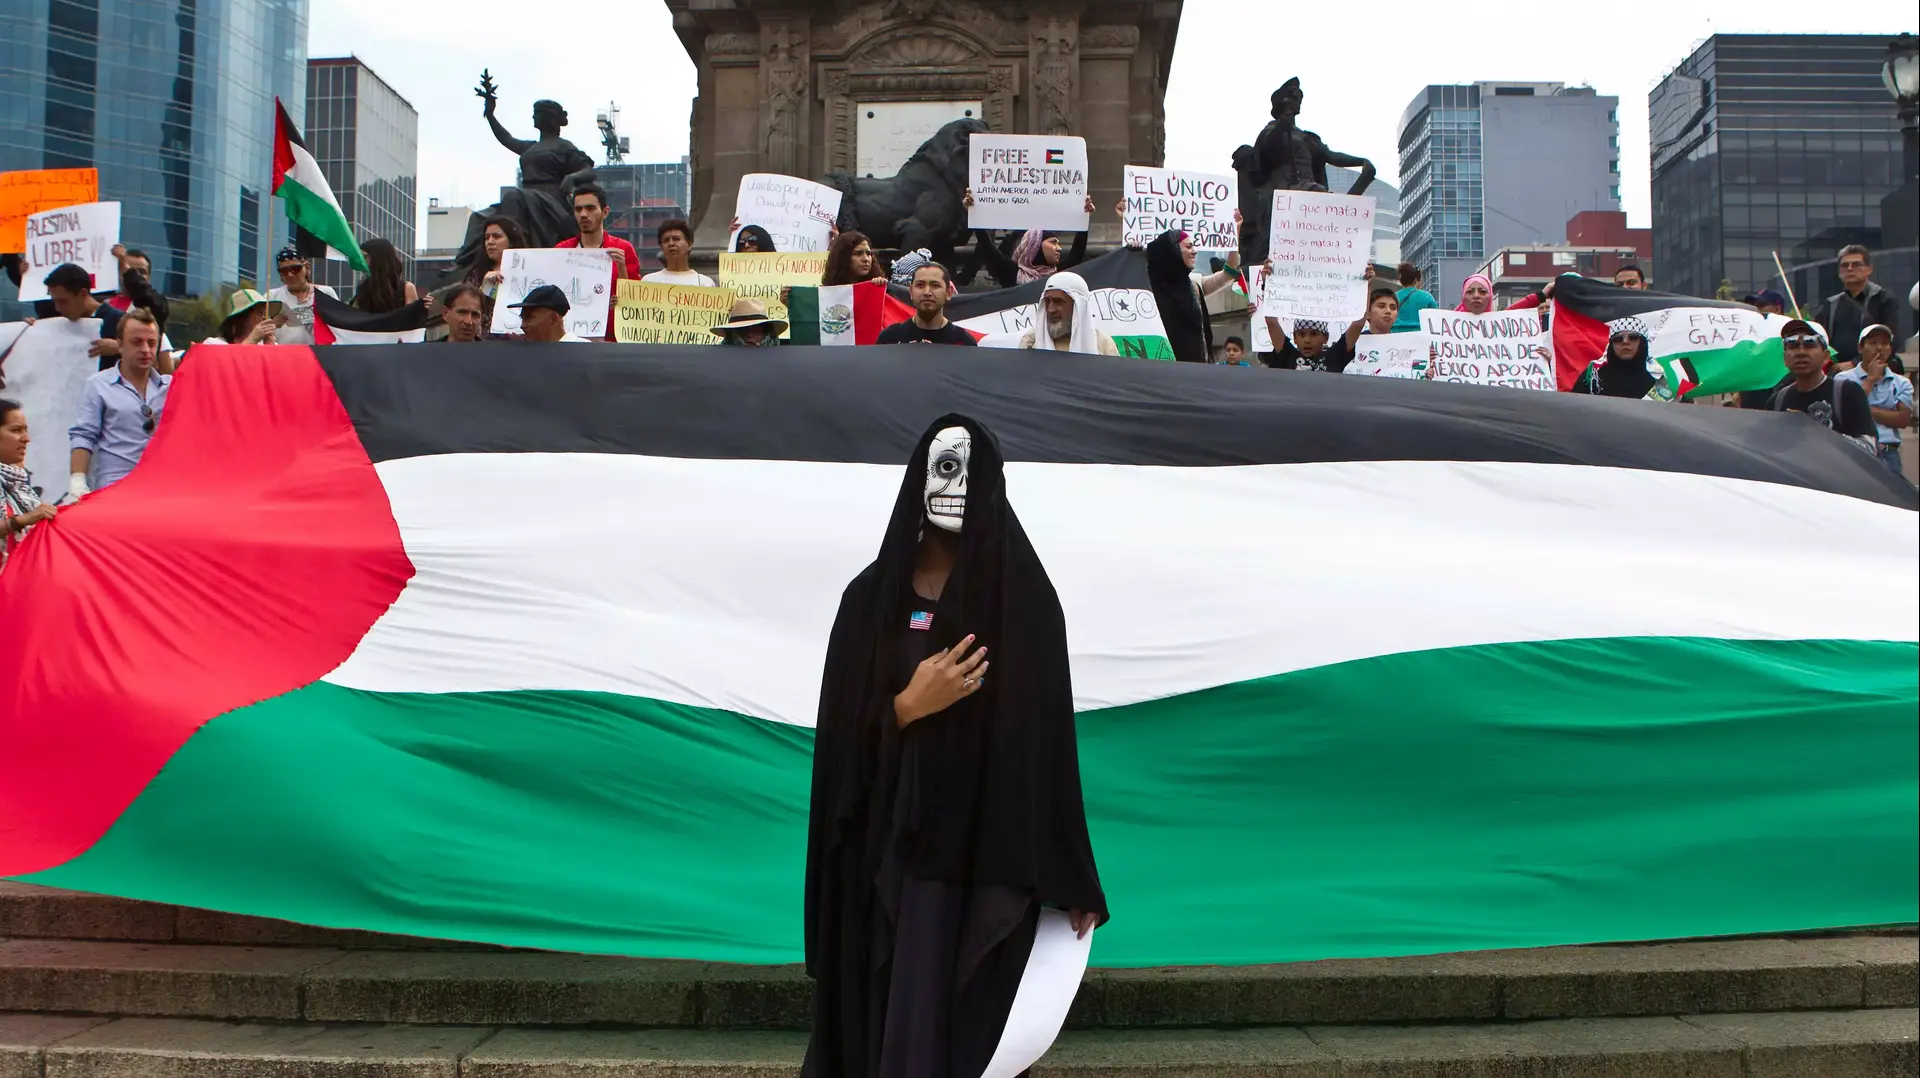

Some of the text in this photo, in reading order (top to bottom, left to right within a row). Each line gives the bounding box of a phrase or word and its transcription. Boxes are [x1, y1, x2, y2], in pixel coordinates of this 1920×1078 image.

[982, 148, 1029, 165] FREE
[980, 167, 1085, 185] PALESTINA
[805, 185, 818, 200] el
[1127, 196, 1216, 219] MEDIO DE
[1275, 195, 1370, 219] El que mata a
[26, 211, 82, 240] PALESTINA
[1124, 215, 1236, 237] VENCER UNA
[1345, 226, 1360, 235] es
[769, 233, 818, 252] ESTINA
[1300, 238, 1308, 246] si
[1310, 239, 1340, 248] matara
[1346, 240, 1353, 249] a
[1272, 248, 1353, 265] toda la humanidad
[621, 306, 665, 325] CONTRA
[1000, 287, 1159, 334] MICO
[1428, 317, 1540, 340] LA COMUNIDAD
[1689, 313, 1741, 327] FREE
[620, 326, 662, 344] AUNQUE
[1688, 325, 1757, 346] GAZA
[1430, 341, 1540, 361] USULMANA DE
[1486, 362, 1546, 378] APOYA
[1447, 377, 1555, 391] ESTINA
